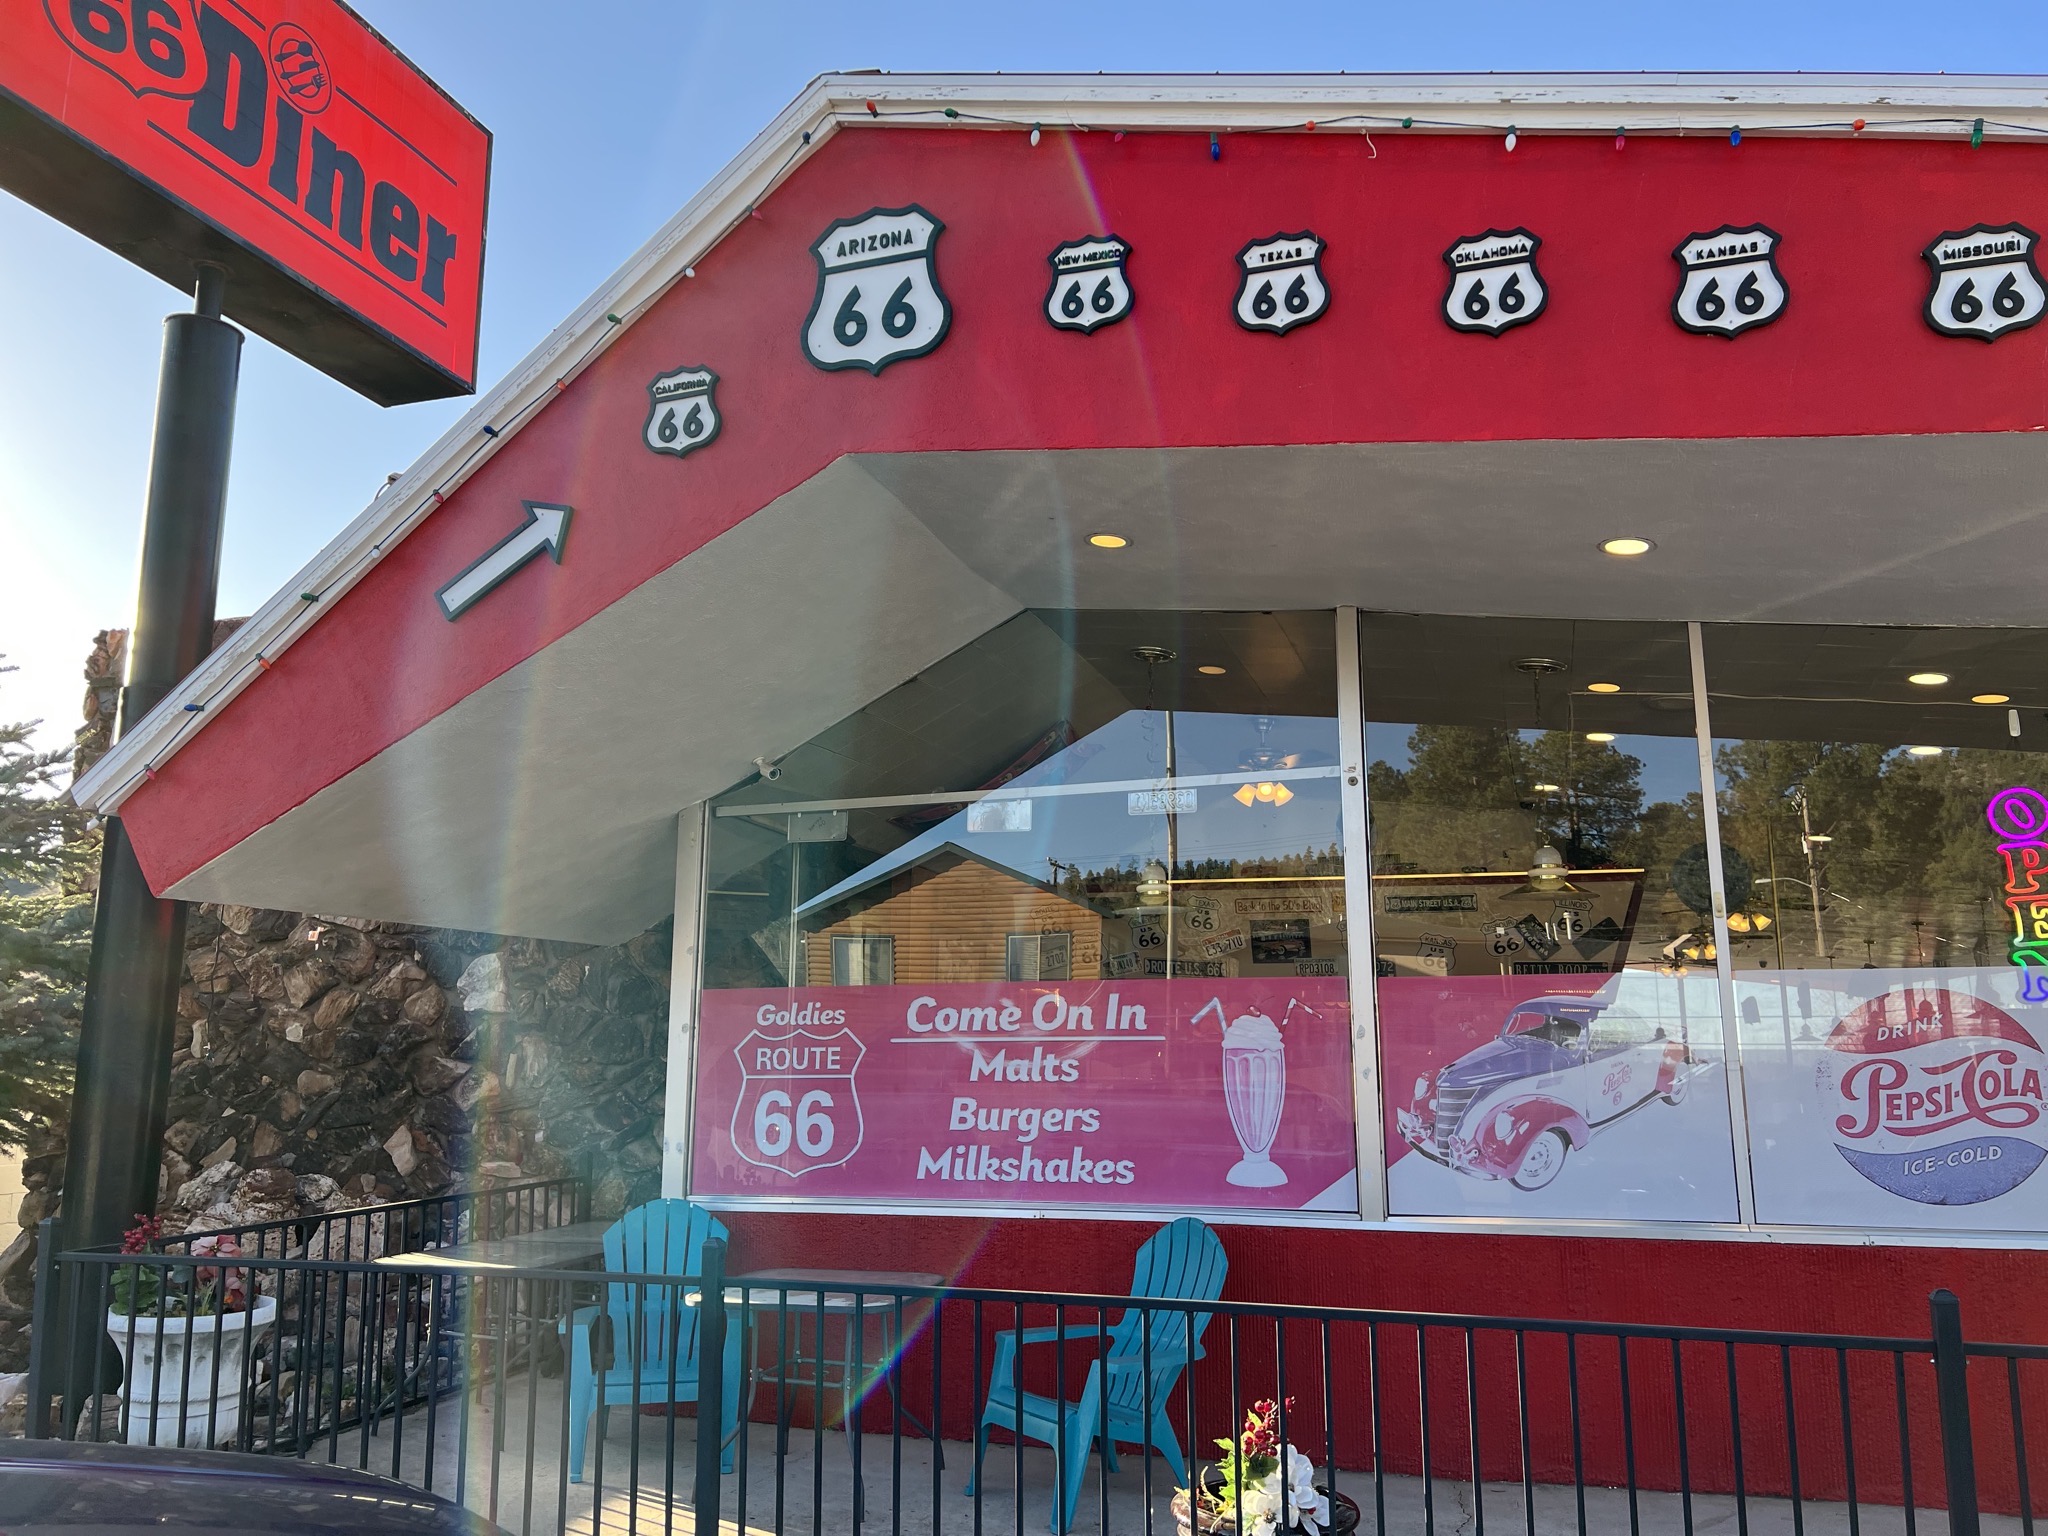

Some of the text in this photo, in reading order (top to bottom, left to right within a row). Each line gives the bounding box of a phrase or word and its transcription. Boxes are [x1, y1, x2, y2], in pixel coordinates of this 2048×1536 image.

[69, 0, 457, 306] 66 Diner
[837, 228, 914, 258] ARIZONA
[1259, 247, 1302, 262] TEXAS
[1456, 242, 1529, 265] OKLAHOMA
[1696, 241, 1758, 260] KANSAS
[1943, 239, 2021, 261] MISSOURI
[1057, 248, 1122, 266] NEW MEXICO
[1061, 275, 1115, 319] 66
[1252, 273, 1309, 319] 66
[1463, 271, 1526, 319] 66
[1696, 270, 1765, 321] 66
[1951, 271, 2026, 323] 66
[833, 276, 917, 347] 66
[655, 378, 708, 396] CALIFORNIA
[657, 402, 704, 443] 66
[1196, 899, 1215, 909] TEXAS
[1401, 900, 1418, 908] MAIN
[1419, 899, 1441, 907] STREET
[1191, 915, 1214, 930] 66
[1558, 917, 1583, 933] 66
[1138, 932, 1161, 948] 66
[1424, 935, 1453, 947] KANSAS
[1430, 946, 1445, 954] US
[1493, 937, 1520, 954] 66
[1045, 951, 1066, 967] 2702
[1151, 960, 1182, 974] ROUTE
[1207, 963, 1220, 976] 66
[1423, 953, 1448, 970] 66
[1515, 964, 1551, 974] BETTY
[1559, 964, 1588, 974] BOOP
[756, 1002, 846, 1027] Goldies
[906, 993, 1148, 1034] Come On In
[1877, 1013, 1944, 1042] DRINK
[756, 1046, 841, 1071] ROUTE
[969, 1047, 1080, 1083] Malts
[754, 1090, 835, 1157] 66
[949, 1097, 1101, 1143] Burgers
[916, 1145, 1136, 1185] Milkshakes
[1903, 1145, 2003, 1176] ICE-COLD
